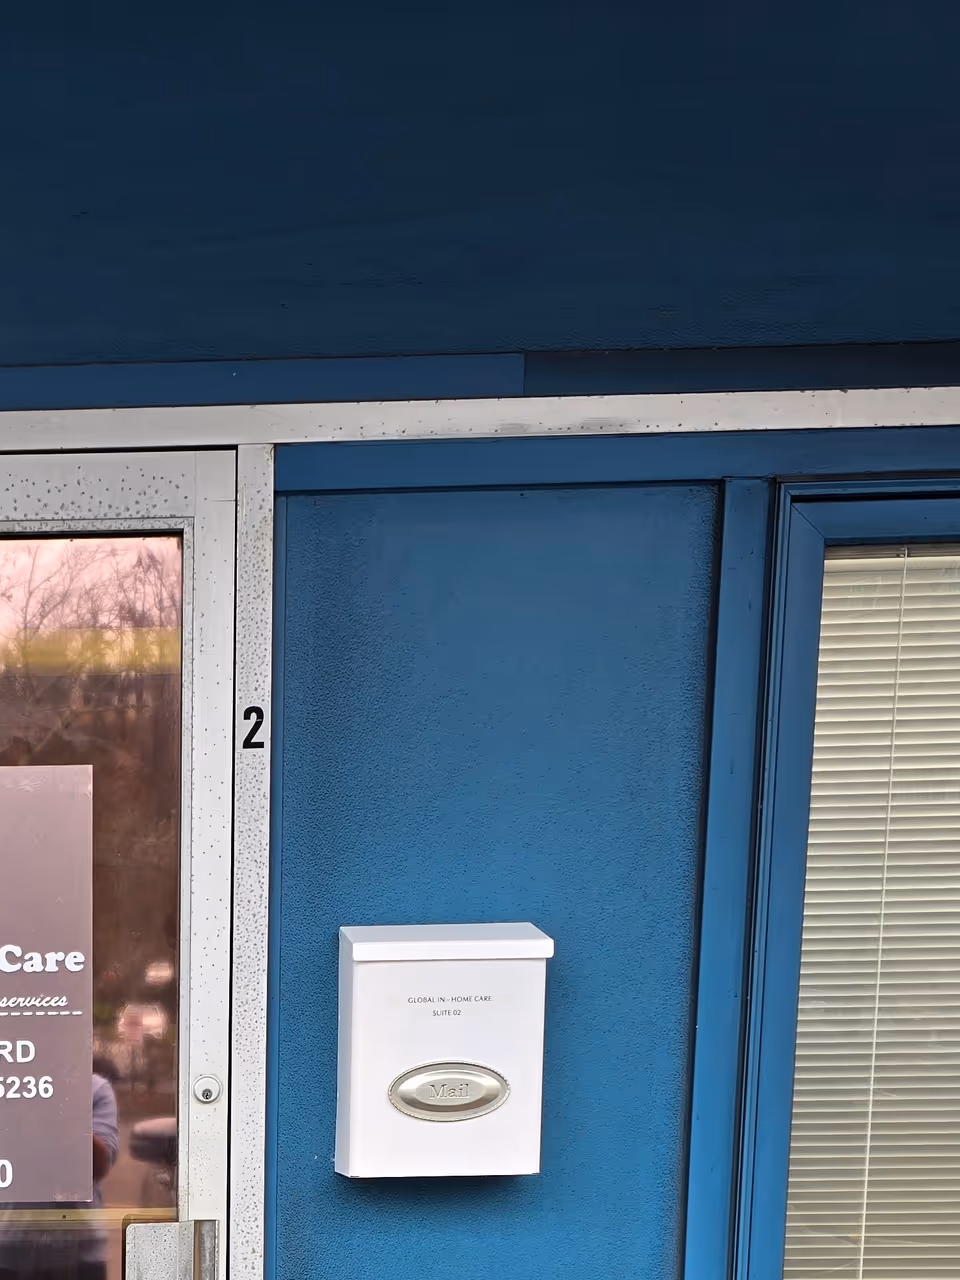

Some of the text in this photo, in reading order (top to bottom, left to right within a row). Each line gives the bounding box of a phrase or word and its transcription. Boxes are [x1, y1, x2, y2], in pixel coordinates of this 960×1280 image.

[242, 705, 265, 749] 2
[407, 996, 435, 1004] GLOBAL
[474, 995, 492, 1003] CARE
[432, 1009, 452, 1017] SUITE
[428, 1083, 470, 1100] Mail
